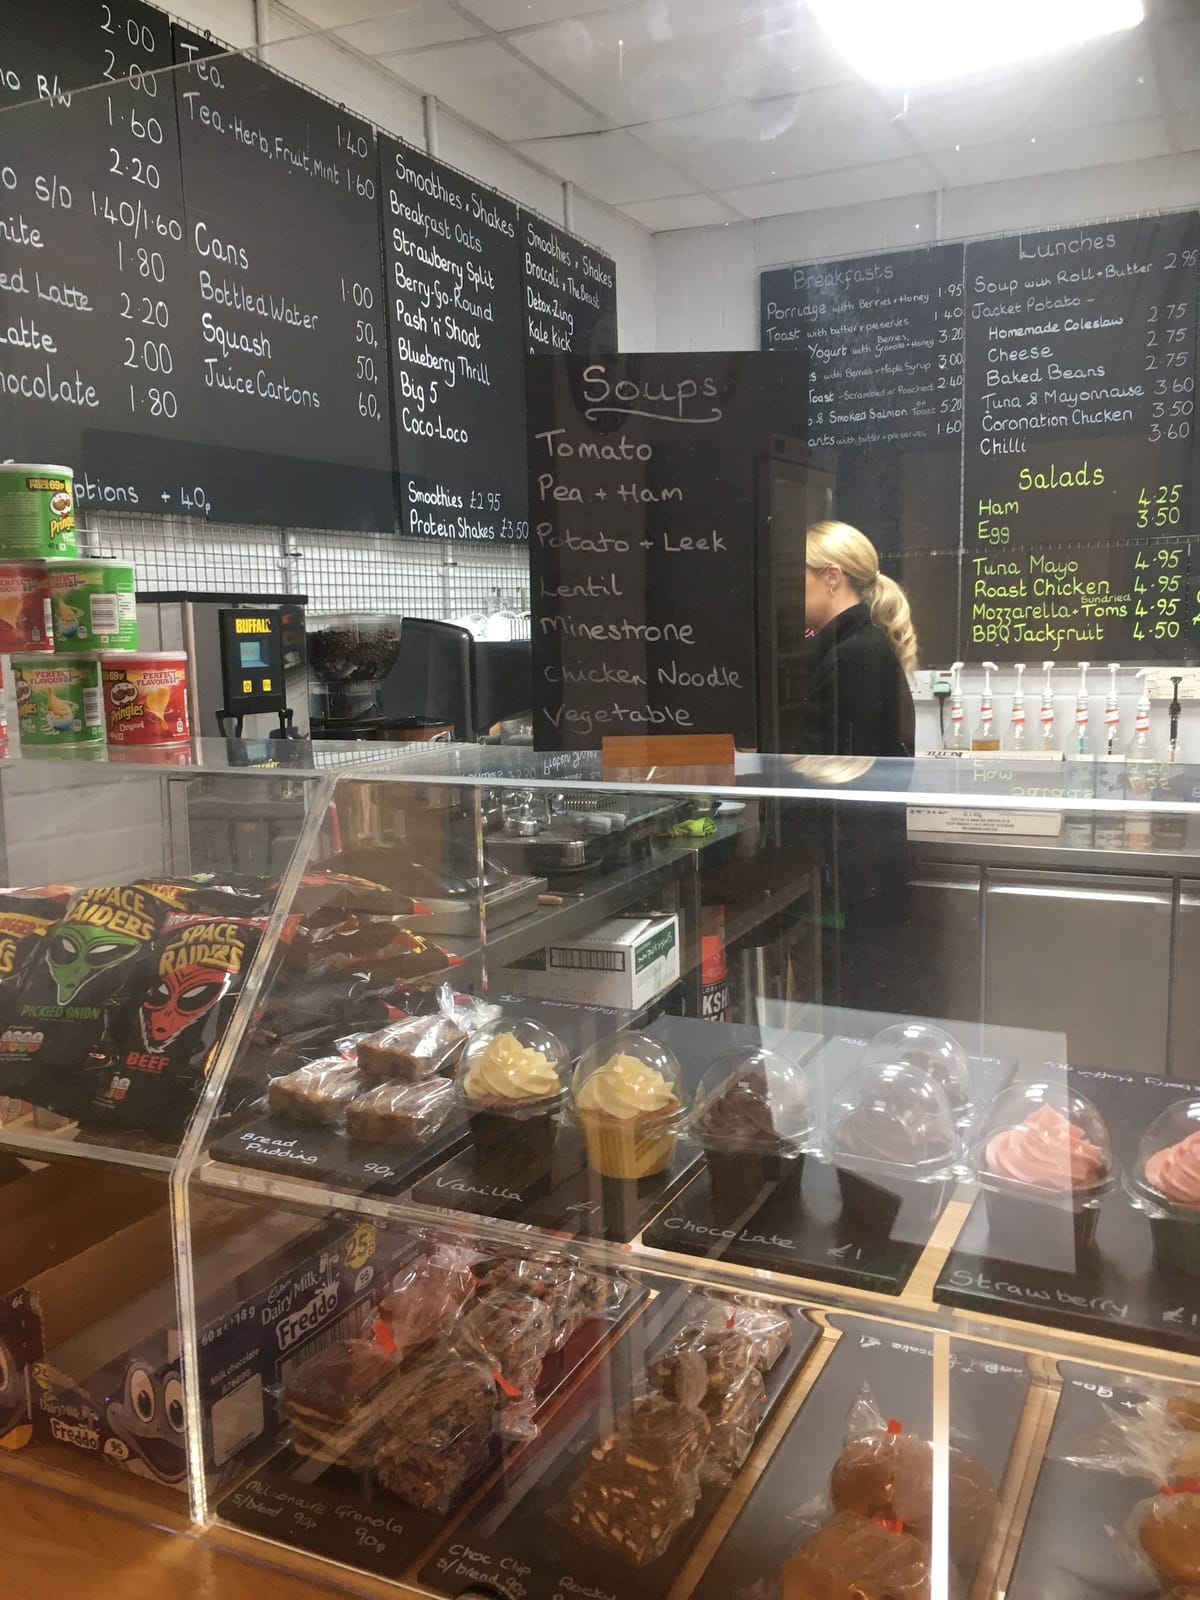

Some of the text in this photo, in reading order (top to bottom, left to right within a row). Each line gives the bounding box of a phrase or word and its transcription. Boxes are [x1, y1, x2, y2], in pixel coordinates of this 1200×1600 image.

[180, 44, 224, 89] Tea
[183, 92, 225, 133] Tea
[314, 158, 339, 185] Mint
[35, 175, 72, 208] S/D
[396, 153, 515, 238] Smoothies Shakes
[389, 189, 482, 252] Breakfast Oats
[194, 222, 250, 270] Cans
[393, 228, 495, 292] Strawberry Split
[527, 222, 613, 288] Smoothies Shakes
[1019, 231, 1116, 261] Lunches
[525, 252, 581, 300] Broccoli The
[793, 263, 895, 291] Breakfasts
[974, 263, 1153, 297] Soup with Roll Butter
[35, 272, 94, 311] Latte
[199, 270, 269, 316] Bottled
[269, 295, 319, 331] Water
[767, 293, 930, 321] Porridge with Berries Honey
[972, 296, 1081, 320] Jacket Potato
[201, 312, 272, 358] Squash
[396, 298, 481, 350] Pash Shoot
[528, 315, 572, 352] Kale Kick
[766, 326, 801, 342] Toast
[807, 328, 827, 338] with
[866, 318, 909, 333] preserves
[989, 315, 1125, 341] Homemade Coleslaw
[398, 336, 491, 387] Blueberry Thrill
[807, 343, 847, 364] Yogurt
[853, 344, 871, 354] with
[911, 338, 934, 349] Honey
[988, 346, 1054, 363] Cheese
[203, 358, 254, 395] Juice
[256, 370, 320, 408] Cartons
[904, 361, 932, 375] Syrup
[986, 363, 1106, 388] Baked Beans
[400, 371, 438, 412] Big 5
[583, 364, 718, 417] Soups
[982, 384, 1145, 411] Tuna & Mayonnaise
[402, 407, 469, 443] Coco-Loco
[829, 409, 867, 424] Smoked
[869, 407, 908, 420] Salmon
[912, 406, 937, 416] Toast
[982, 409, 1133, 433] Coronation Chicken
[535, 429, 653, 461] Tomato
[980, 437, 1027, 455] Chilli
[538, 473, 683, 503] Pea + Ham
[1018, 461, 1105, 490] Salads
[180, 486, 211, 512] 40p
[408, 480, 463, 509] Smoothies
[978, 499, 1019, 516] Ham
[410, 509, 495, 539] Protein Shakes
[536, 522, 728, 552] Potato + Leek
[978, 520, 1010, 545] Egg
[972, 557, 1021, 576] Tuna
[1030, 554, 1079, 581] Mayo
[540, 573, 623, 597] Lentil
[974, 578, 1027, 598] Roast
[1033, 577, 1110, 597] Chicken
[1081, 593, 1132, 604] Sundried
[973, 602, 1072, 628] Mozzarella
[1081, 603, 1128, 617] Toms
[540, 616, 696, 645] Minestrone
[973, 624, 1010, 645] BBQ
[1013, 621, 1105, 652] Jackfruit
[544, 658, 743, 689] Chicken Noodle
[111, 701, 144, 727] Pringles
[543, 703, 694, 735] Vegetable
[173, 923, 243, 949] SPACE
[159, 943, 244, 976] RAIDERS
[126, 1051, 170, 1074] BEEF
[239, 1131, 396, 1178] Bread 90p
[245, 1142, 318, 1165] Pudding
[436, 1176, 524, 1202] Vanilla
[663, 1216, 862, 1261] Chocolate £1
[261, 1290, 294, 1326] Dairy
[292, 1269, 319, 1300] Milk
[948, 1269, 1130, 1320] Strawberry
[278, 1292, 339, 1348] Freddo
[52, 1421, 98, 1449] Freddo
[110, 1441, 124, 1455] 95
[334, 1504, 403, 1535] Granola
[355, 1527, 387, 1553] 90p
[448, 1544, 492, 1565] Choc
